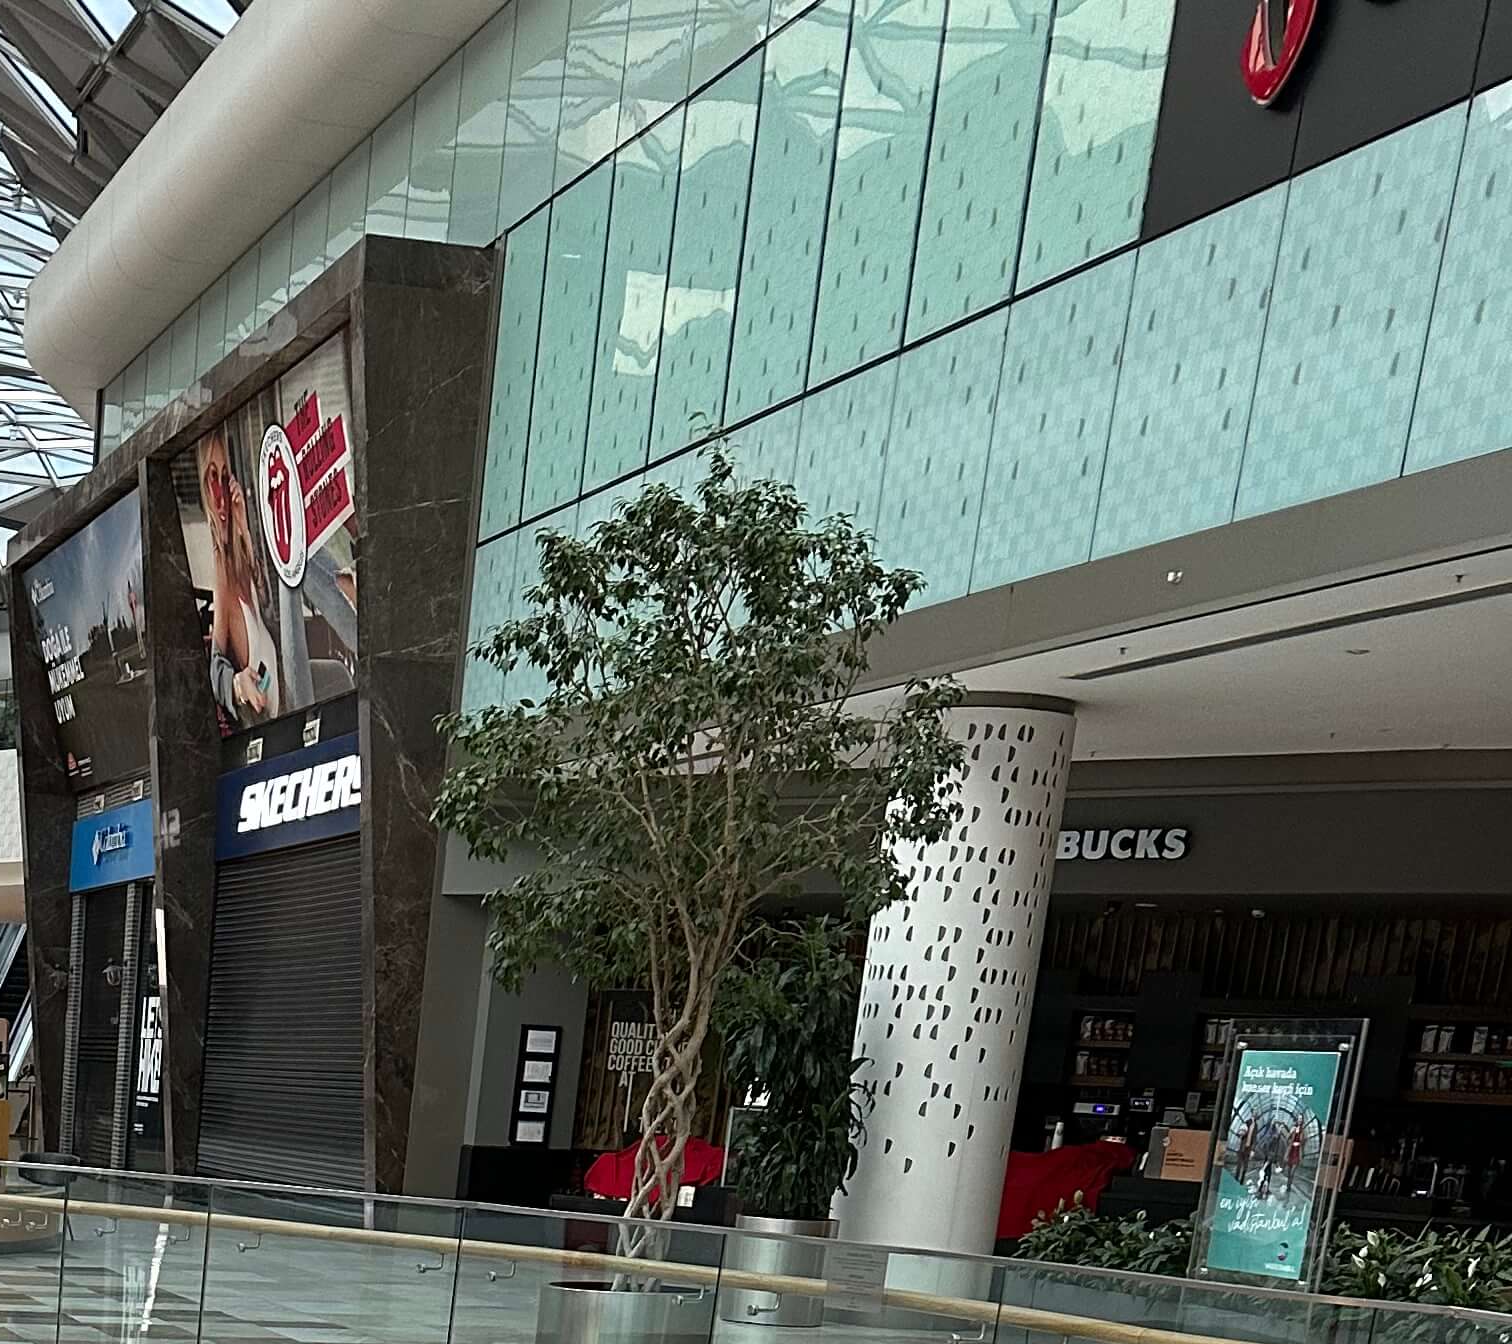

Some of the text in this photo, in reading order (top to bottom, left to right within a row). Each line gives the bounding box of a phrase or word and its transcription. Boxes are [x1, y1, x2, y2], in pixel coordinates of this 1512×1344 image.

[237, 754, 362, 833] SKECHERS
[1055, 828, 1188, 860] BUCKS
[611, 1021, 657, 1039] QUALIT
[609, 1038, 644, 1056] GOOD
[607, 1054, 654, 1073] COFFEE
